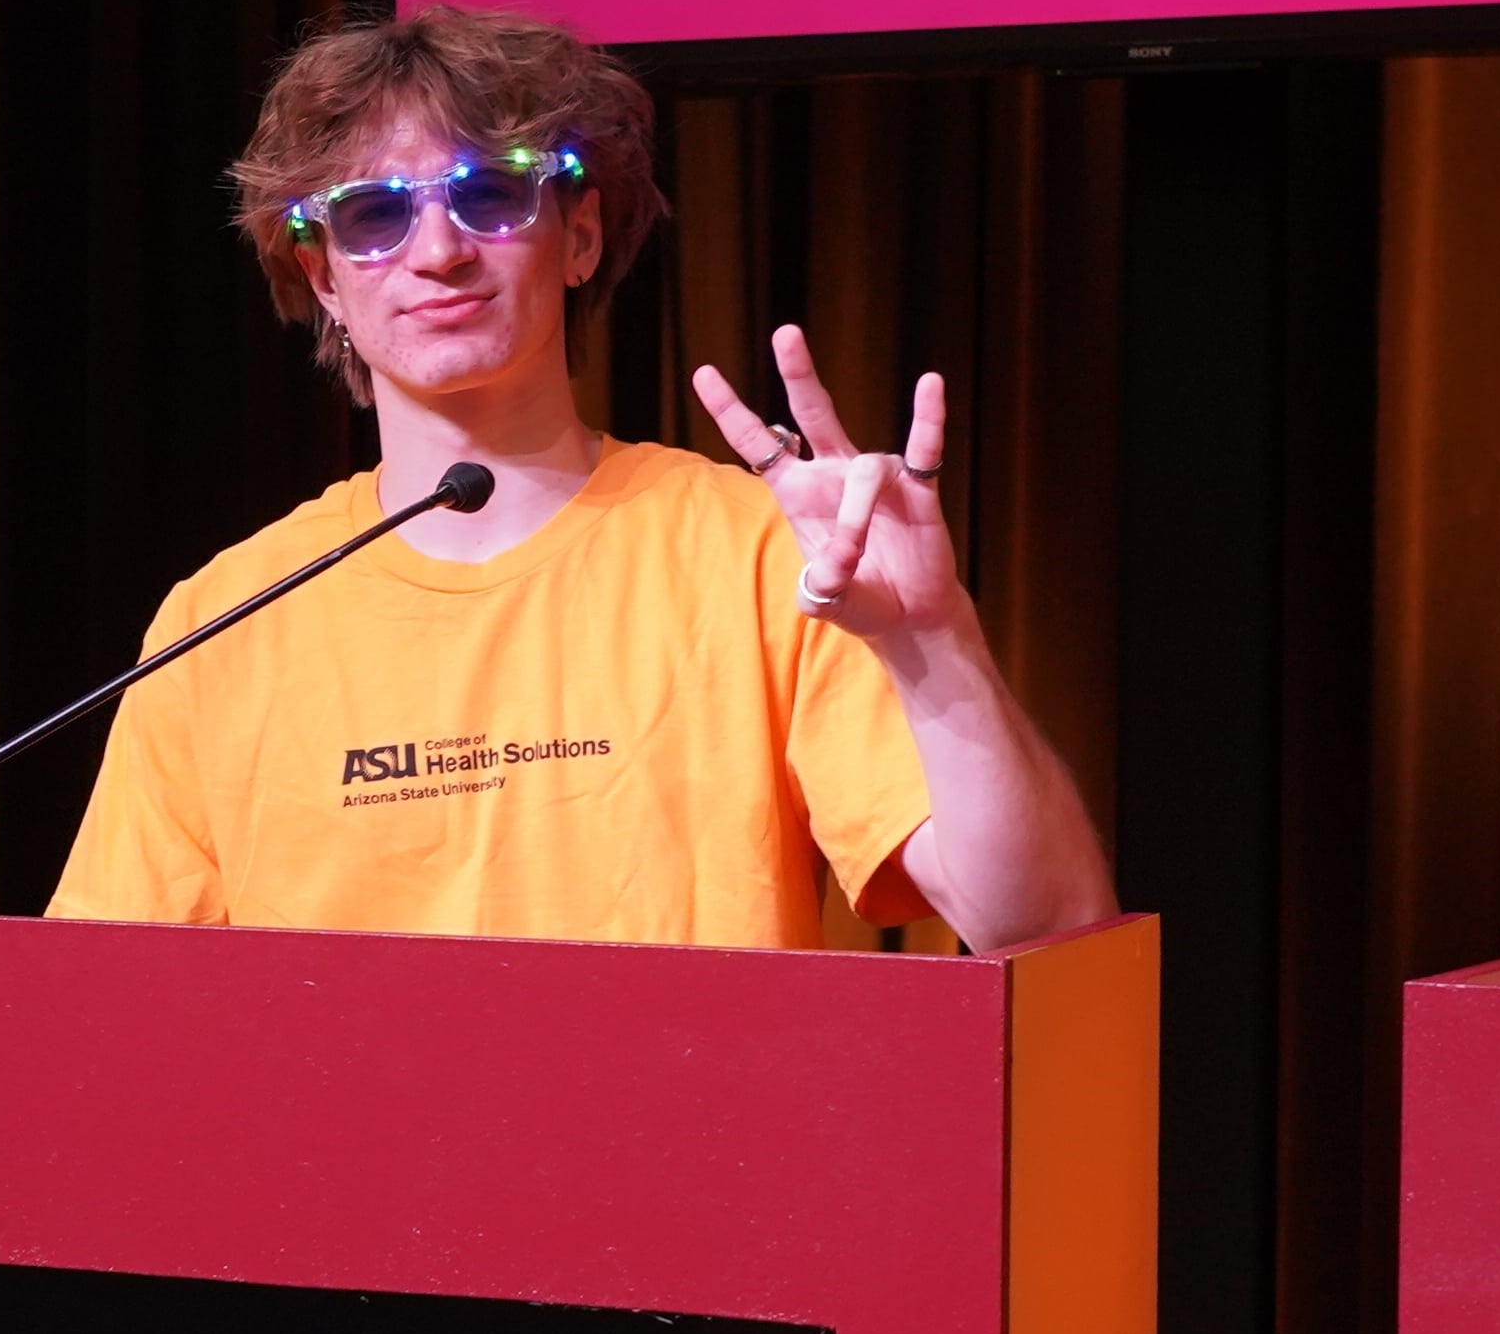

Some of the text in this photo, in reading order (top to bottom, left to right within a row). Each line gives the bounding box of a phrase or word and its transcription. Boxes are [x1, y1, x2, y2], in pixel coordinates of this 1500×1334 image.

[1127, 47, 1172, 58] SONY
[425, 733, 487, 752] College of
[426, 737, 611, 776] Health Solutions
[342, 742, 419, 786] ASU
[343, 775, 506, 808] Arizona State University
